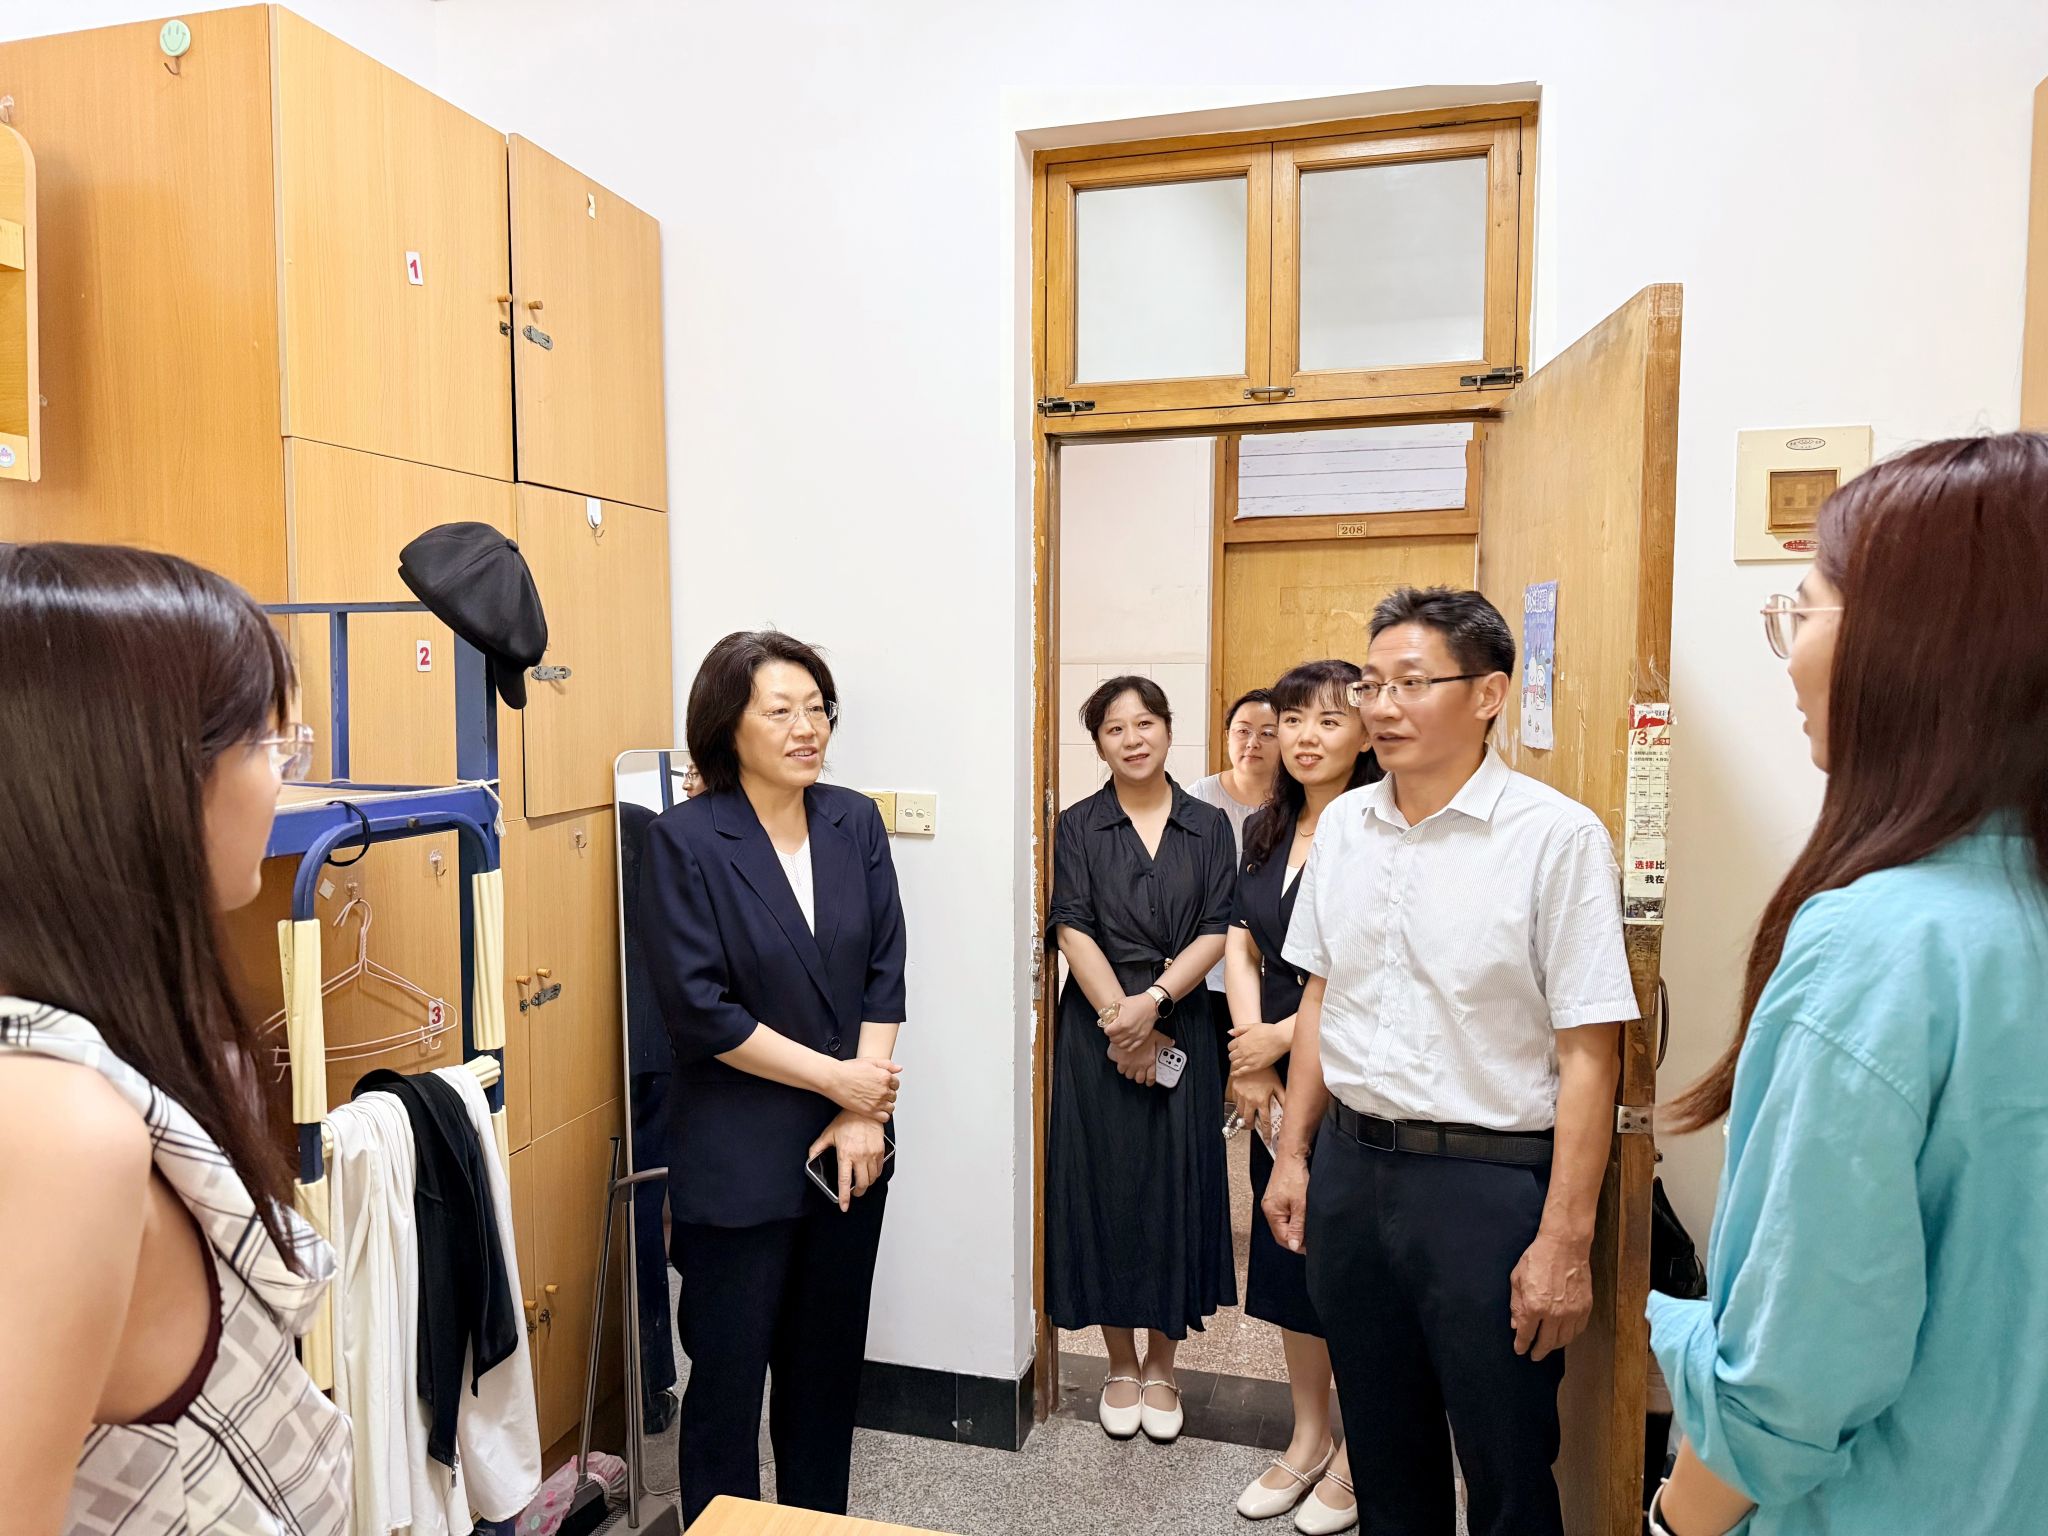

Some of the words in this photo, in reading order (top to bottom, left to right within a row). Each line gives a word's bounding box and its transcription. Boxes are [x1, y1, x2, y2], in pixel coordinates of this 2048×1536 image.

[410, 259, 419, 279] 1
[1341, 525, 1363, 535] 208
[419, 646, 430, 666] 2
[1634, 860, 1665, 870] 选择比
[1644, 874, 1665, 884] 我在
[432, 1006, 442, 1025] 3
